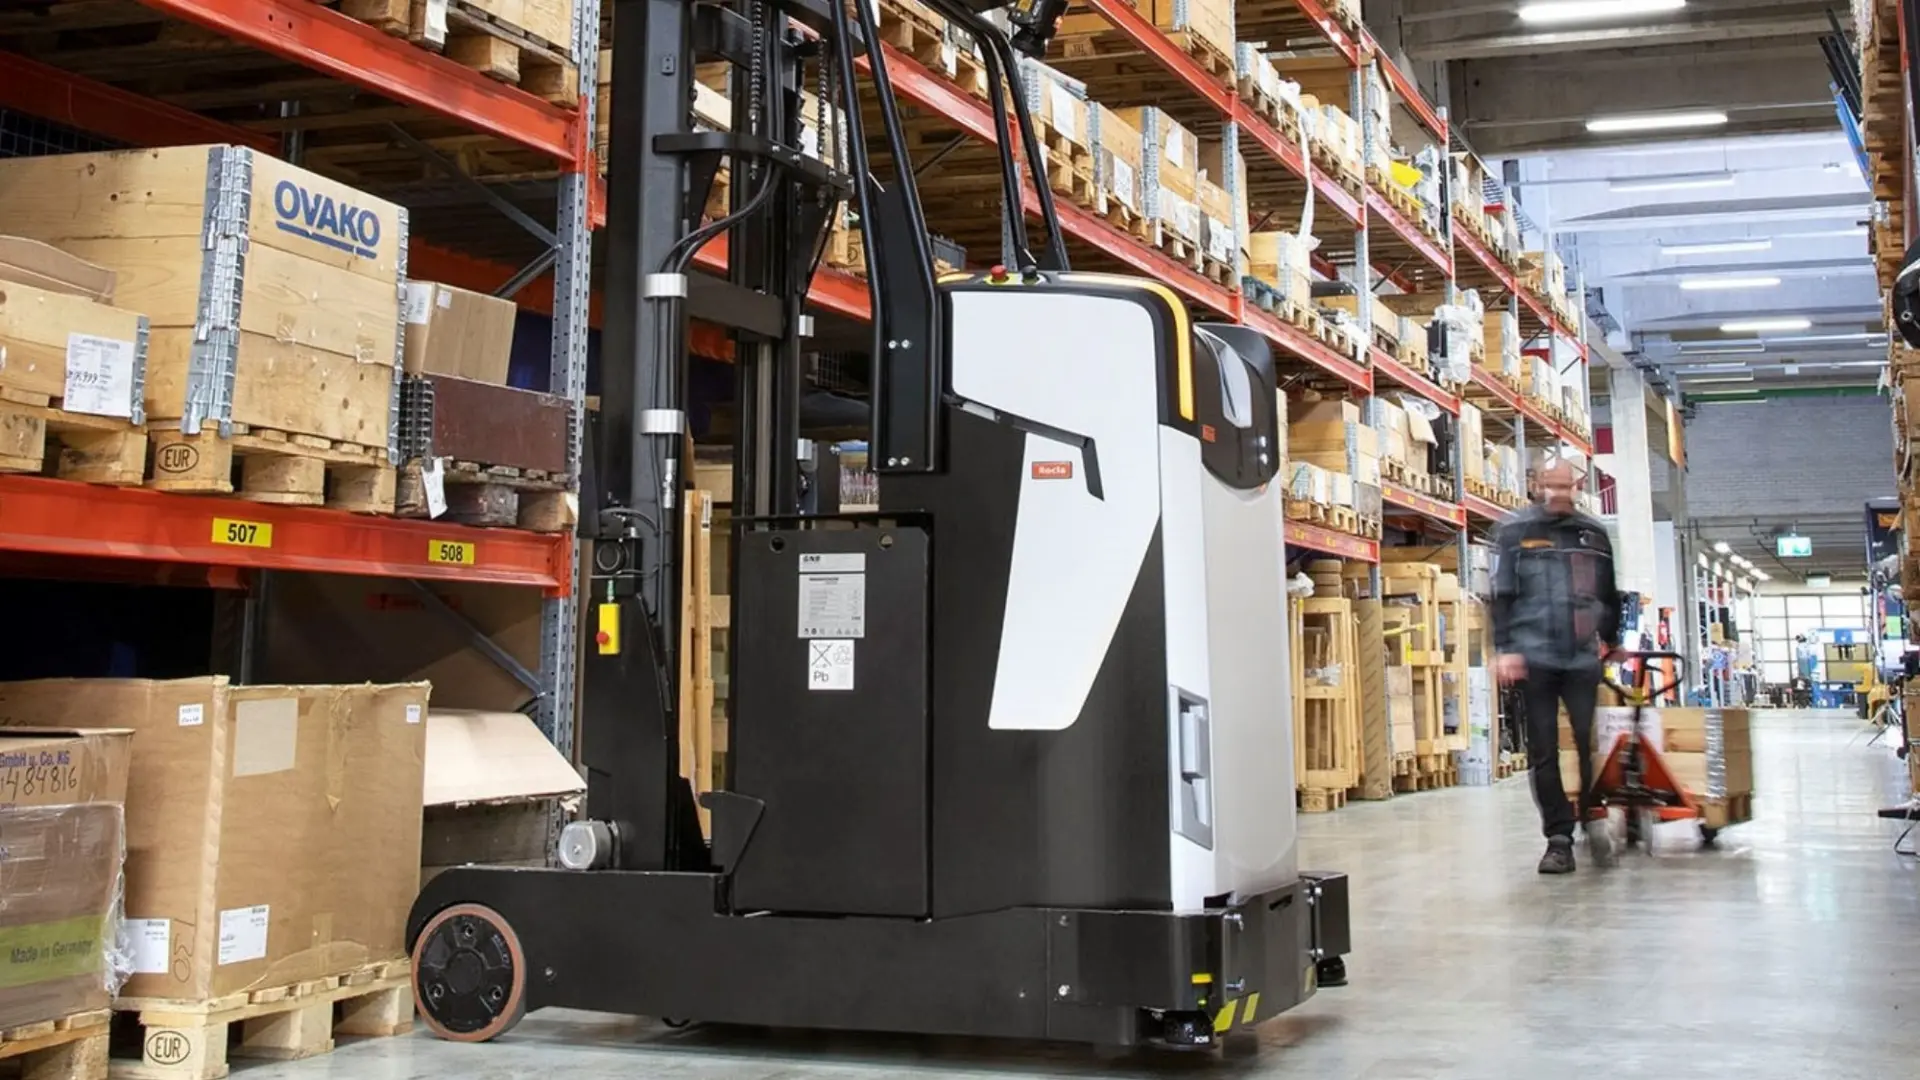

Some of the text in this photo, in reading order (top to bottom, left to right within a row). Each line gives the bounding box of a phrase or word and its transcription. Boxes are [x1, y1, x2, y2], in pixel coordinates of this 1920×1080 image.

[274, 180, 380, 247] OVAKO
[164, 448, 191, 468] EUR
[1038, 465, 1067, 475] Rocla
[227, 523, 257, 544] 507
[440, 544, 464, 562] 508
[813, 671, 829, 682] Pb
[154, 1036, 182, 1059] EUR
